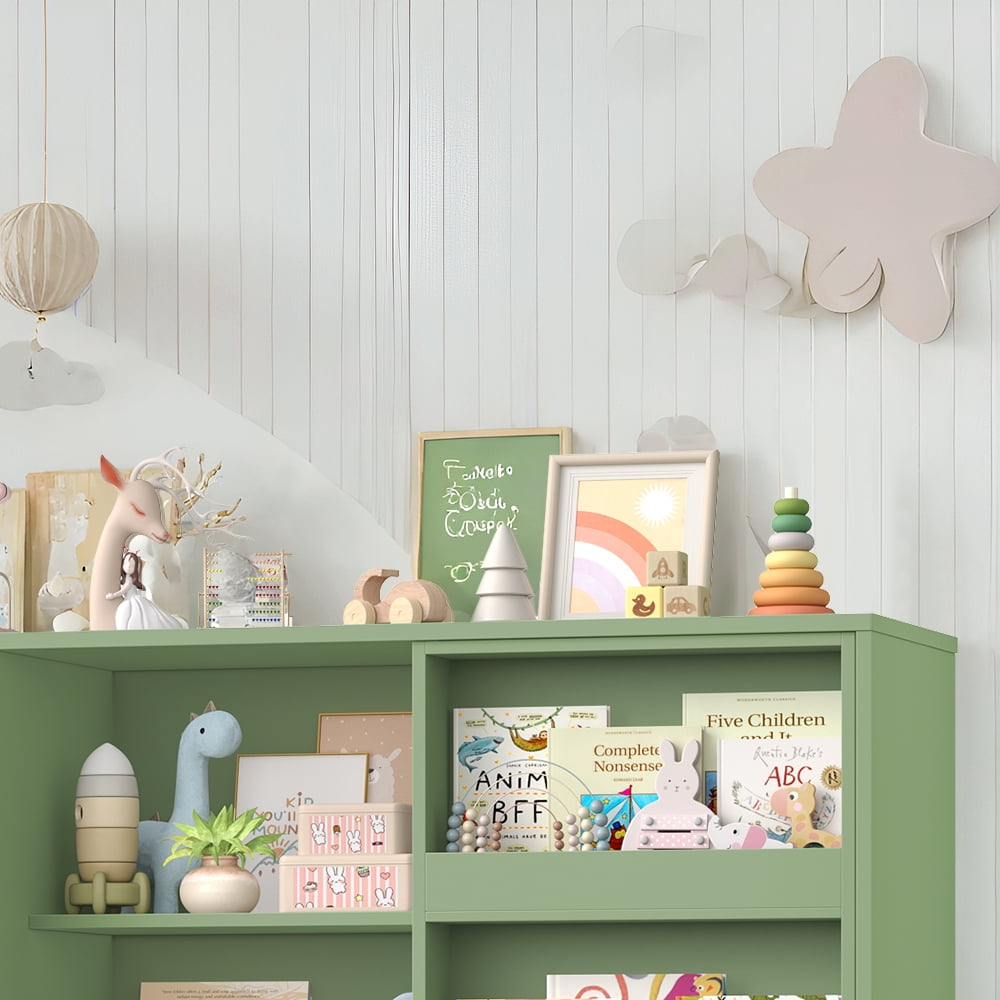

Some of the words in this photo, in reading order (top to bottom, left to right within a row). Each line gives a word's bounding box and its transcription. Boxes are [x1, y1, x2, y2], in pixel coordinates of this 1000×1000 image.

[707, 714, 743, 728] Five
[748, 712, 825, 728] Children
[594, 744, 660, 759] Complete
[594, 761, 663, 772] Nonsense
[764, 765, 813, 788] ABC
[493, 800, 547, 824] BFF
